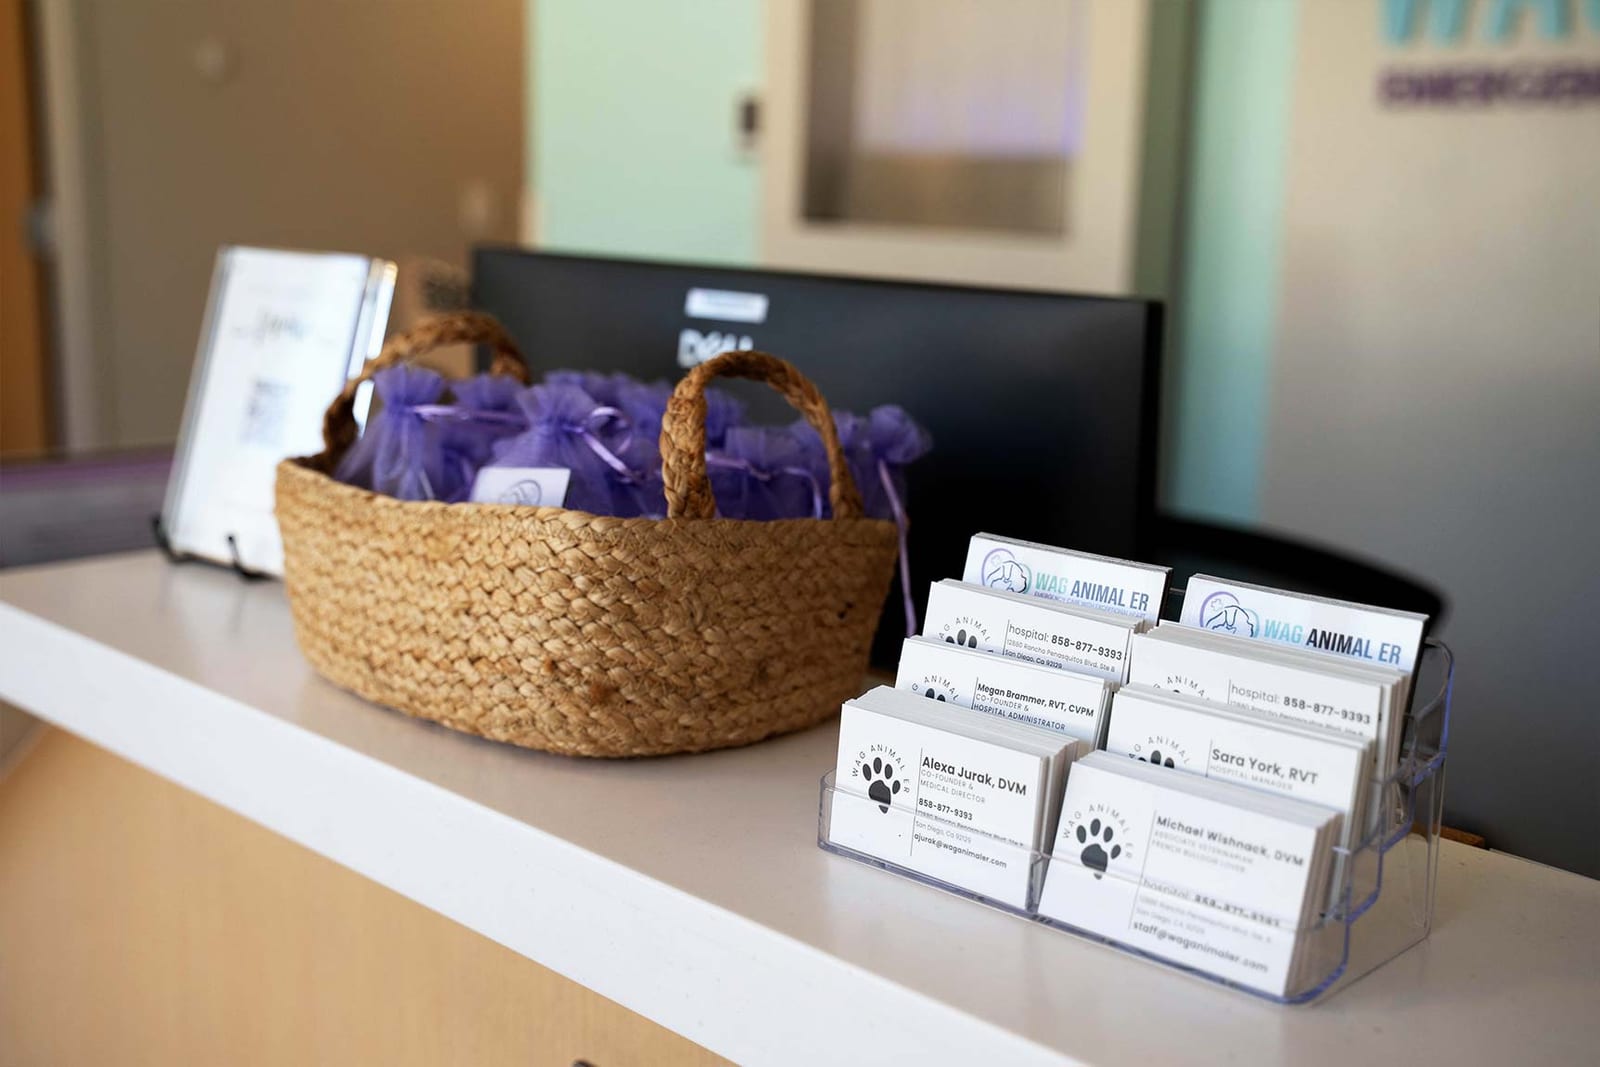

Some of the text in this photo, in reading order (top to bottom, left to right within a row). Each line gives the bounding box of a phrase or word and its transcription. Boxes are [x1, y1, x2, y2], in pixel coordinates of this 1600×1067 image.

[1377, 0, 1600, 46] WA
[1035, 572, 1149, 611] WAG ANIMAL ER
[955, 616, 991, 642] ANIMAL
[1009, 624, 1122, 661] hospital: 858-877-9393
[1264, 619, 1401, 665] WAG ANIMAL ER
[1005, 649, 1017, 657] San
[1024, 643, 1046, 655] Rancho
[1046, 649, 1083, 664] Penasquitos
[924, 675, 959, 701] ANIMAL
[975, 693, 1021, 709] CO-FOUNDER
[977, 683, 1094, 717] Megan Brammer, RVT, CVPM
[974, 703, 1066, 731] HOSPITAL ADMINISTRATOR
[1231, 684, 1279, 704] hospital:
[1283, 696, 1371, 725] 858-877-9393
[871, 744, 905, 771] ANIMAL
[1212, 748, 1318, 785] Sara York, RVT
[920, 769, 967, 787] CO-FOUNDER
[920, 779, 986, 803] MEDICAL DIRECTOR
[922, 756, 1027, 796] Alexa Jurak, DVM
[915, 820, 927, 828] San
[918, 797, 973, 821] 858-877-9393
[914, 832, 1007, 869] ajurak@waganimaler.com
[1157, 816, 1304, 866] Michael Wishnack, DVM
[1133, 920, 1269, 973] staff@waganimaler.com
